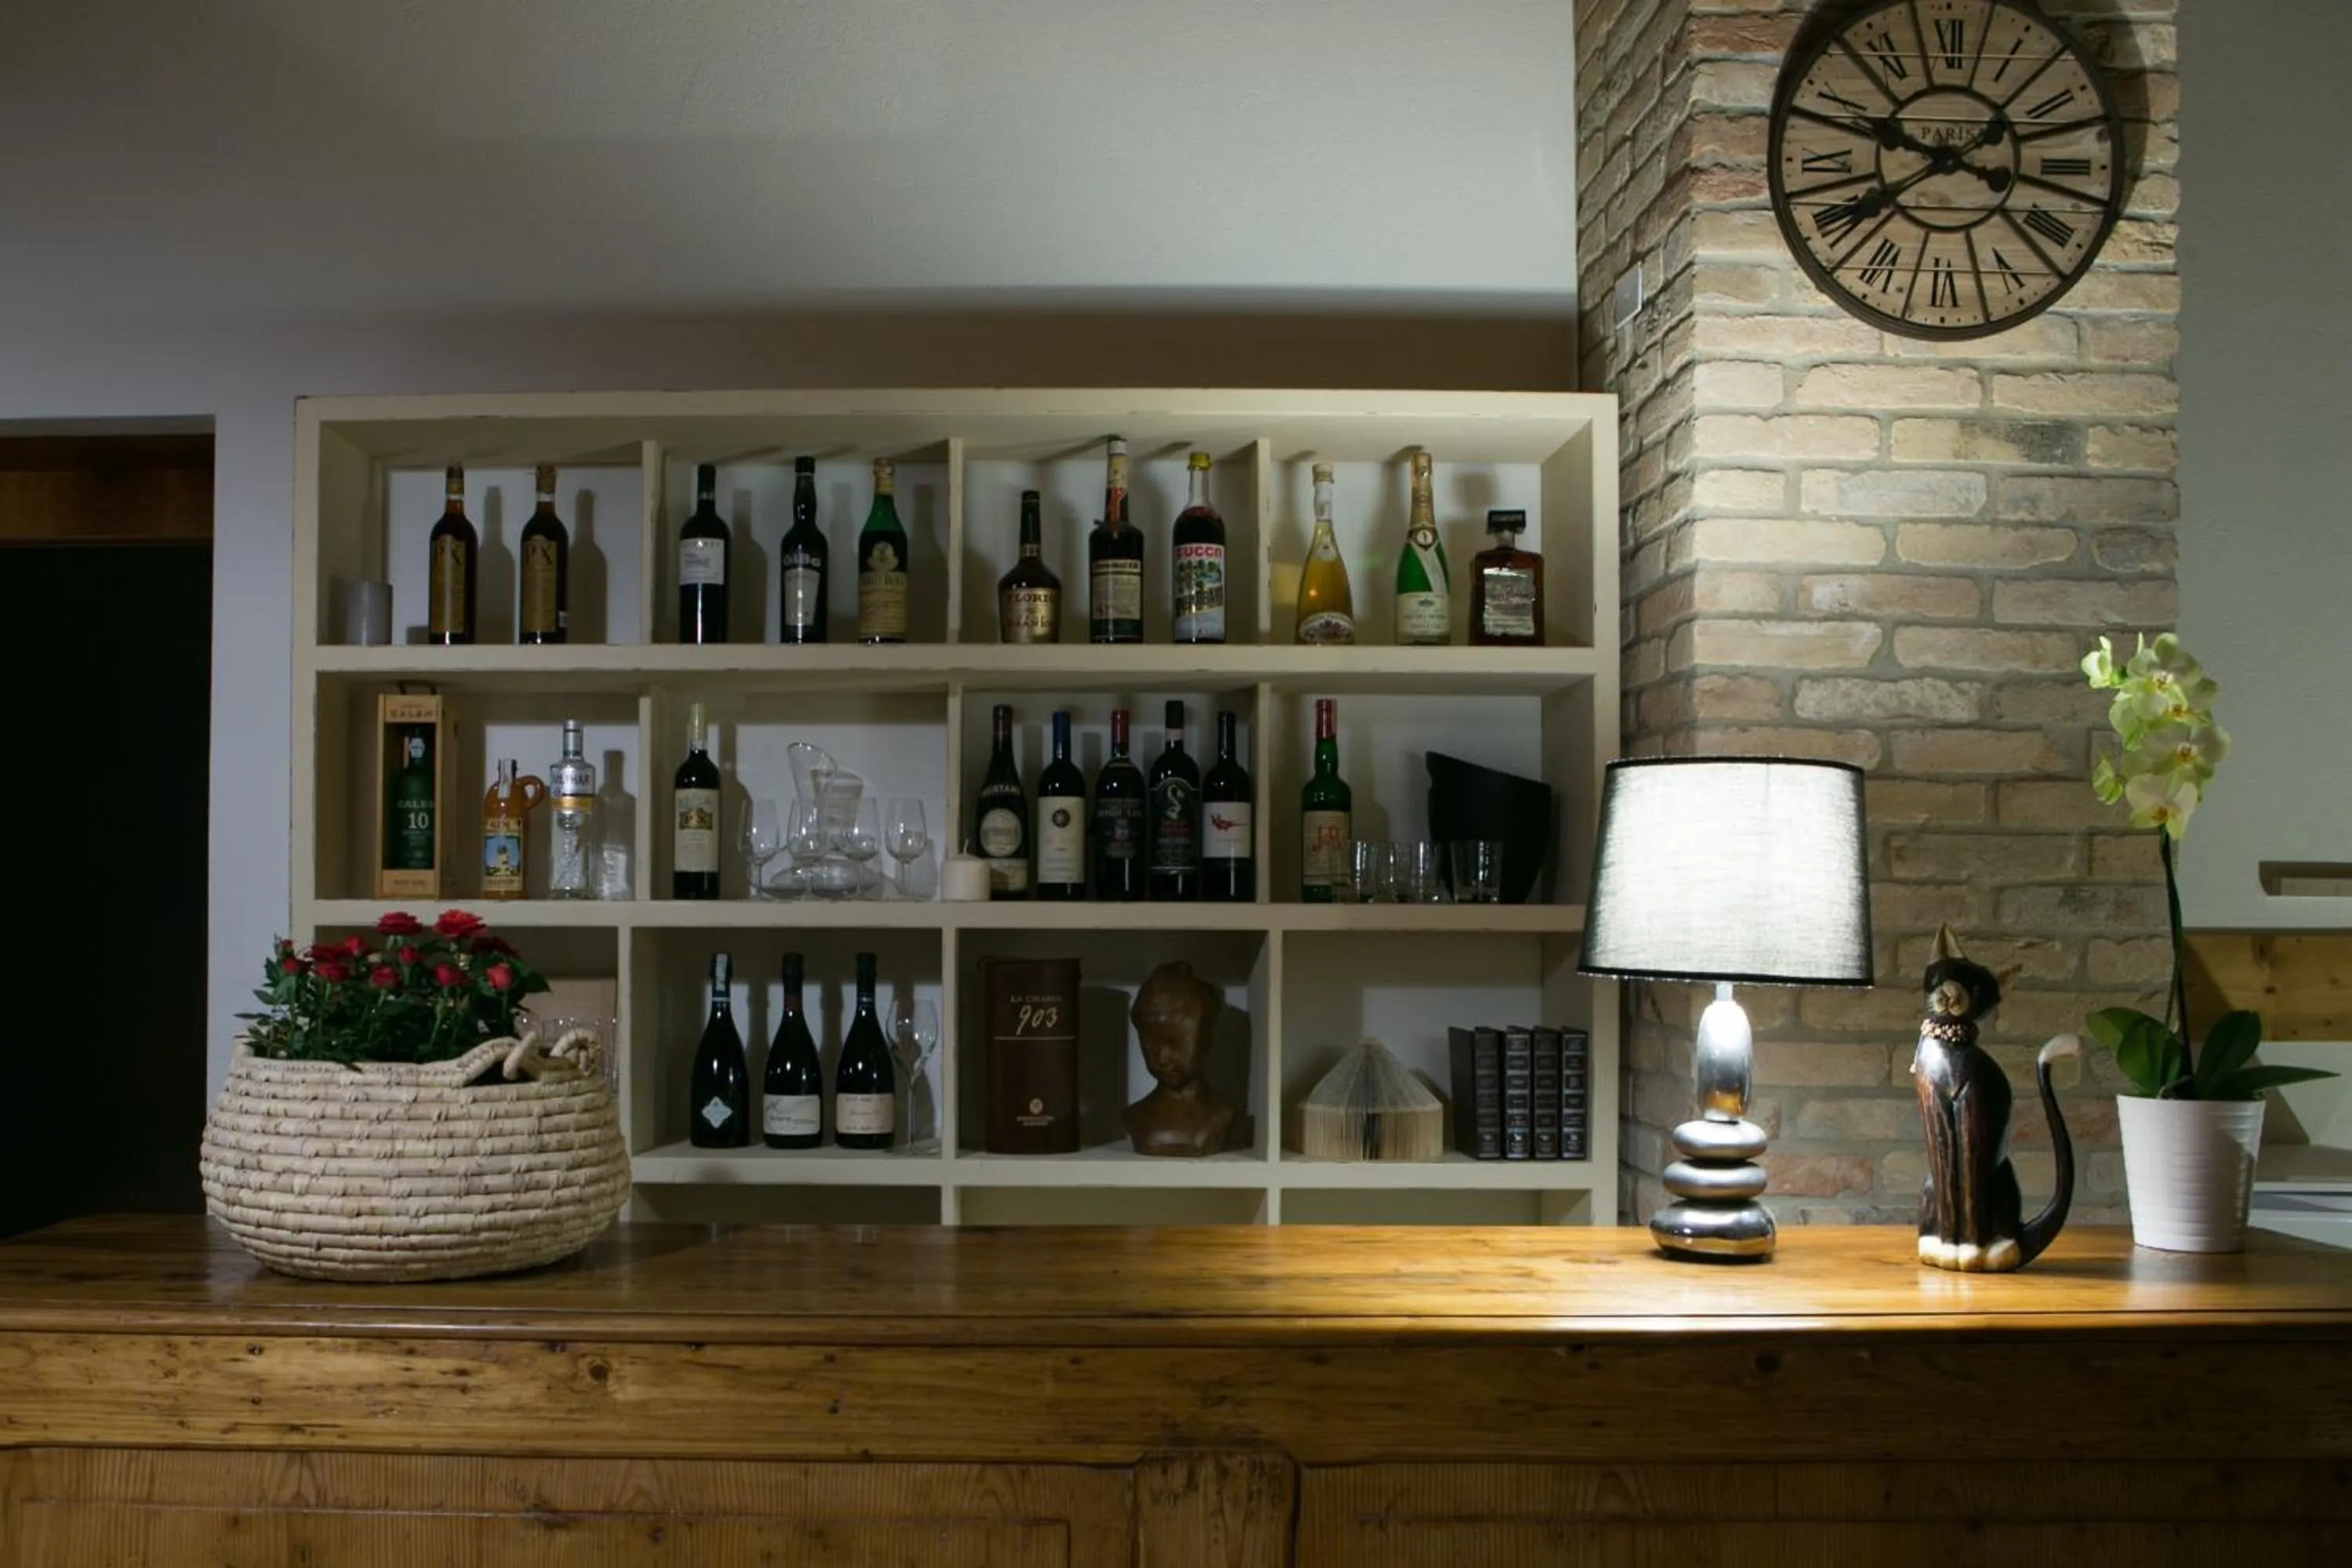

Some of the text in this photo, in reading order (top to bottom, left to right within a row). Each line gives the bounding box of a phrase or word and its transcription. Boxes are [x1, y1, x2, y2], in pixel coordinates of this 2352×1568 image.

[1866, 32, 1908, 82] XI
[1932, 19, 1964, 69] XII
[2026, 88, 2074, 118] II
[1922, 125, 1974, 141] PARIS
[1802, 147, 1853, 175] IX
[2041, 158, 2091, 176] III
[1857, 238, 1901, 294] VII
[1931, 257, 1959, 307] VI
[1992, 247, 2025, 295] V
[408, 811, 429, 829] 10
[1015, 1004, 1058, 1036] 903
